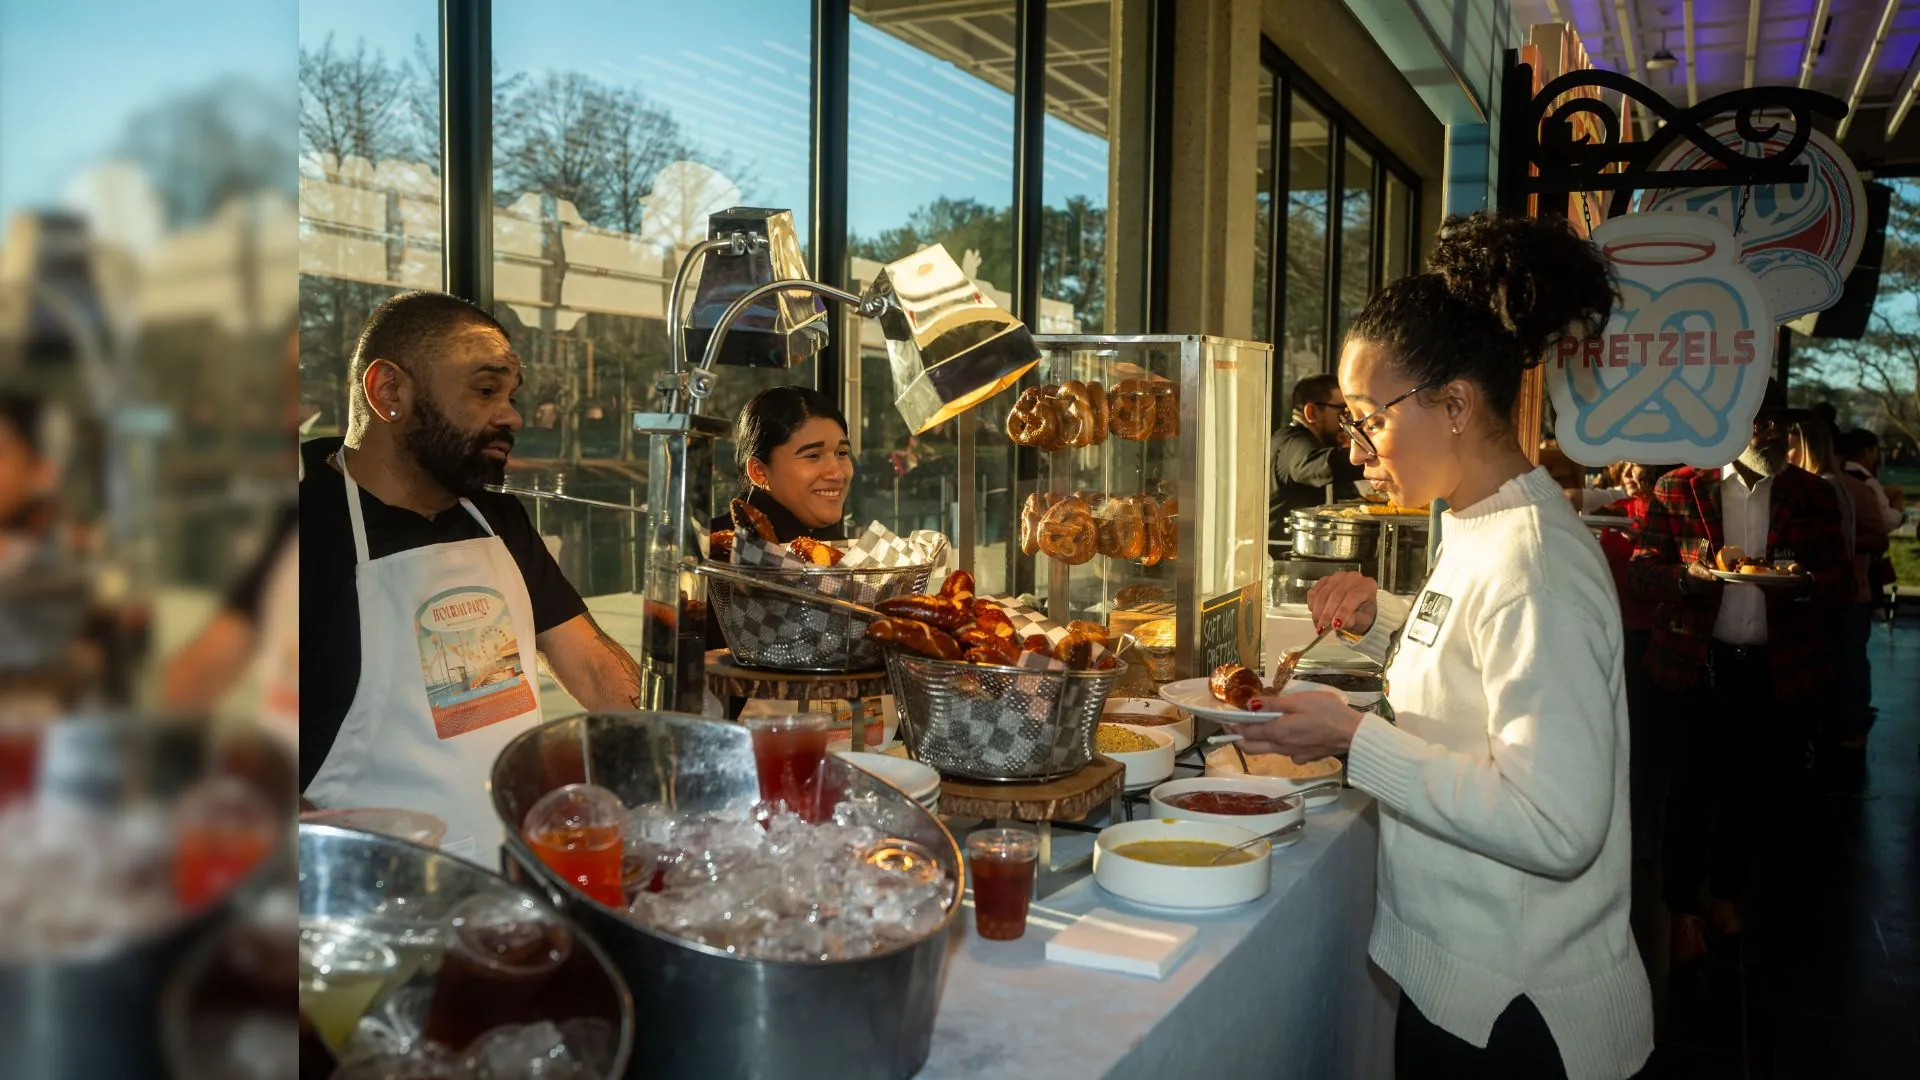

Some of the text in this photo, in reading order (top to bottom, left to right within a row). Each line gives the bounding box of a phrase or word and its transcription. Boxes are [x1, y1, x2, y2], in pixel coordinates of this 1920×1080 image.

[1557, 329, 1755, 369] PRETZELS
[432, 602, 467, 622] HOLIDAY
[466, 597, 490, 616] PARTY
[1203, 608, 1236, 647] SOFT HOT
